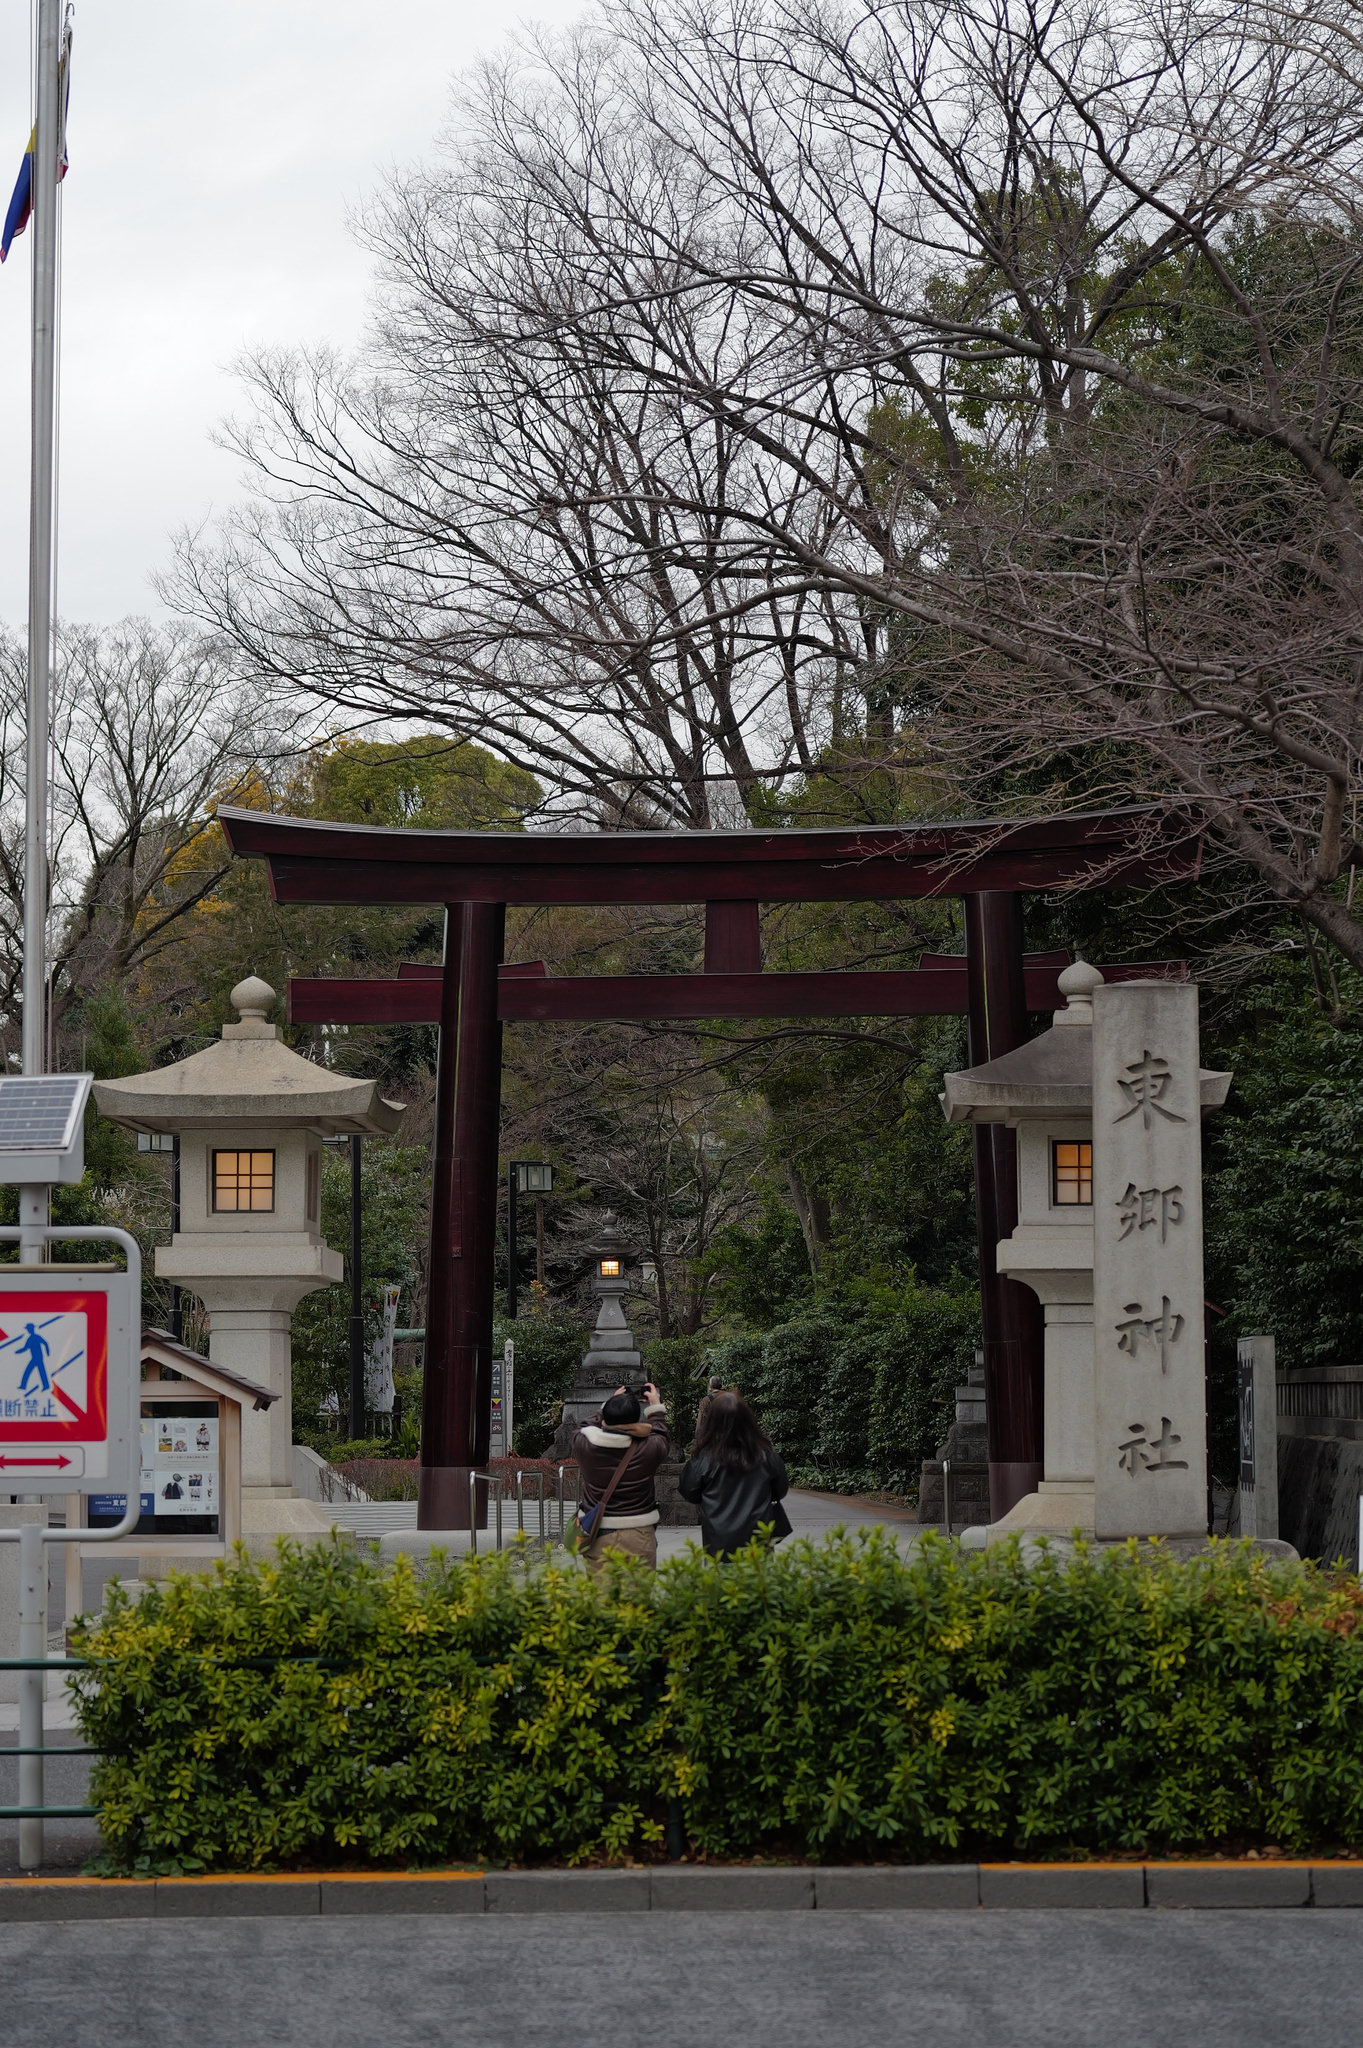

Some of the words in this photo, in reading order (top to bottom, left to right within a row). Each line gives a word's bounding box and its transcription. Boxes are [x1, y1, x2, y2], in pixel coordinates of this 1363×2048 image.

[1112, 1049, 1189, 1478] 東郷神社
[0, 1398, 57, 1417] 断禁止
